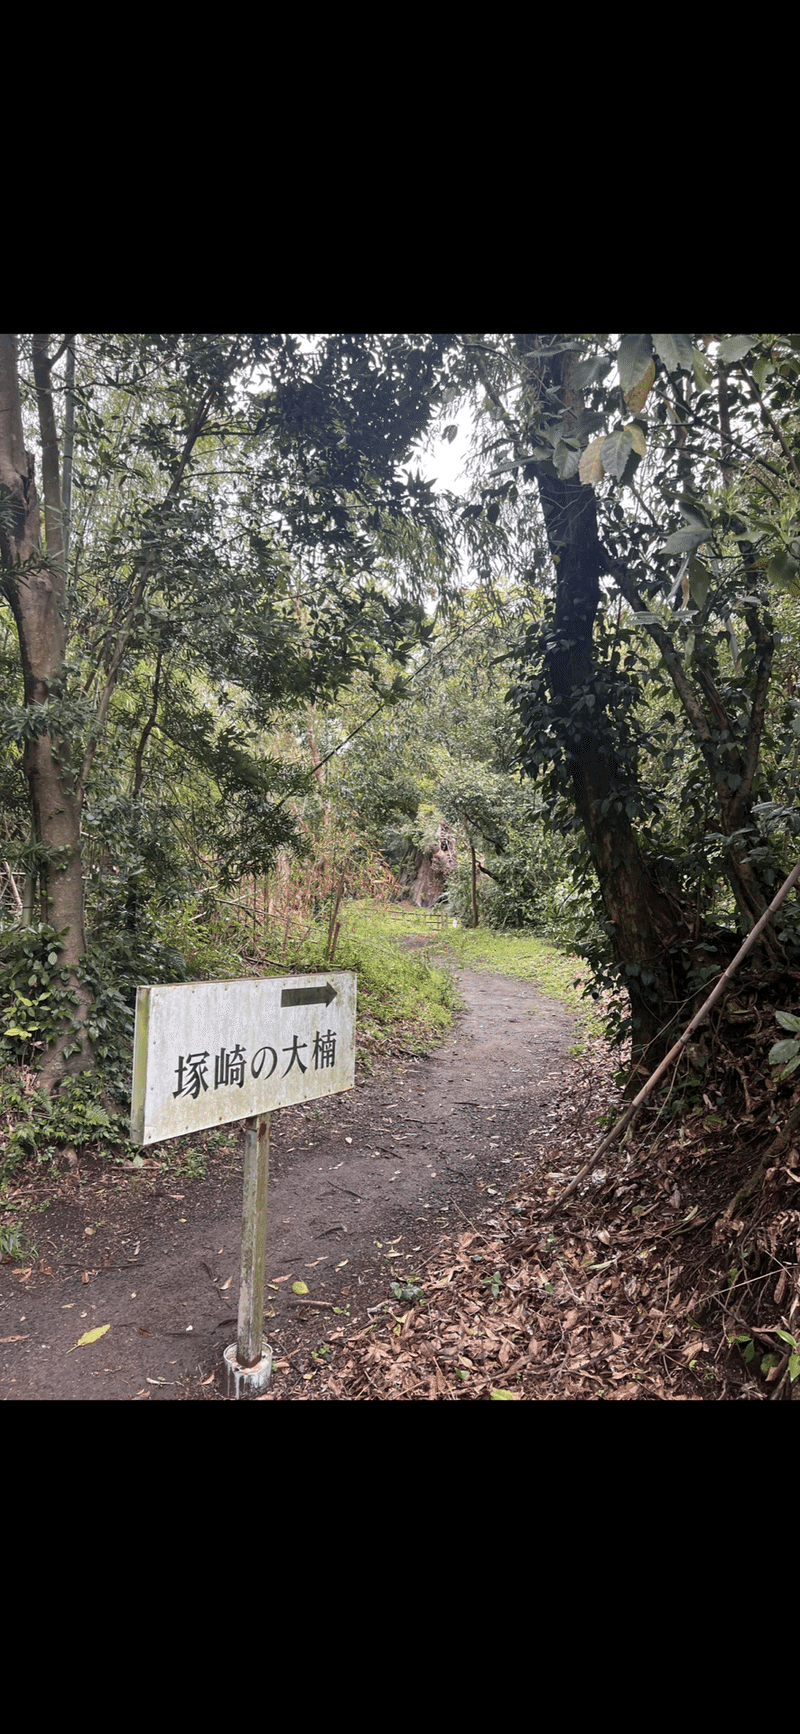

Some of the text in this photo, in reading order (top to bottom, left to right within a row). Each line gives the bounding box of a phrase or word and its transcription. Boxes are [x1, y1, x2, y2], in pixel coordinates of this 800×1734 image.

[172, 1029, 337, 1099] 塚崎の大楠
